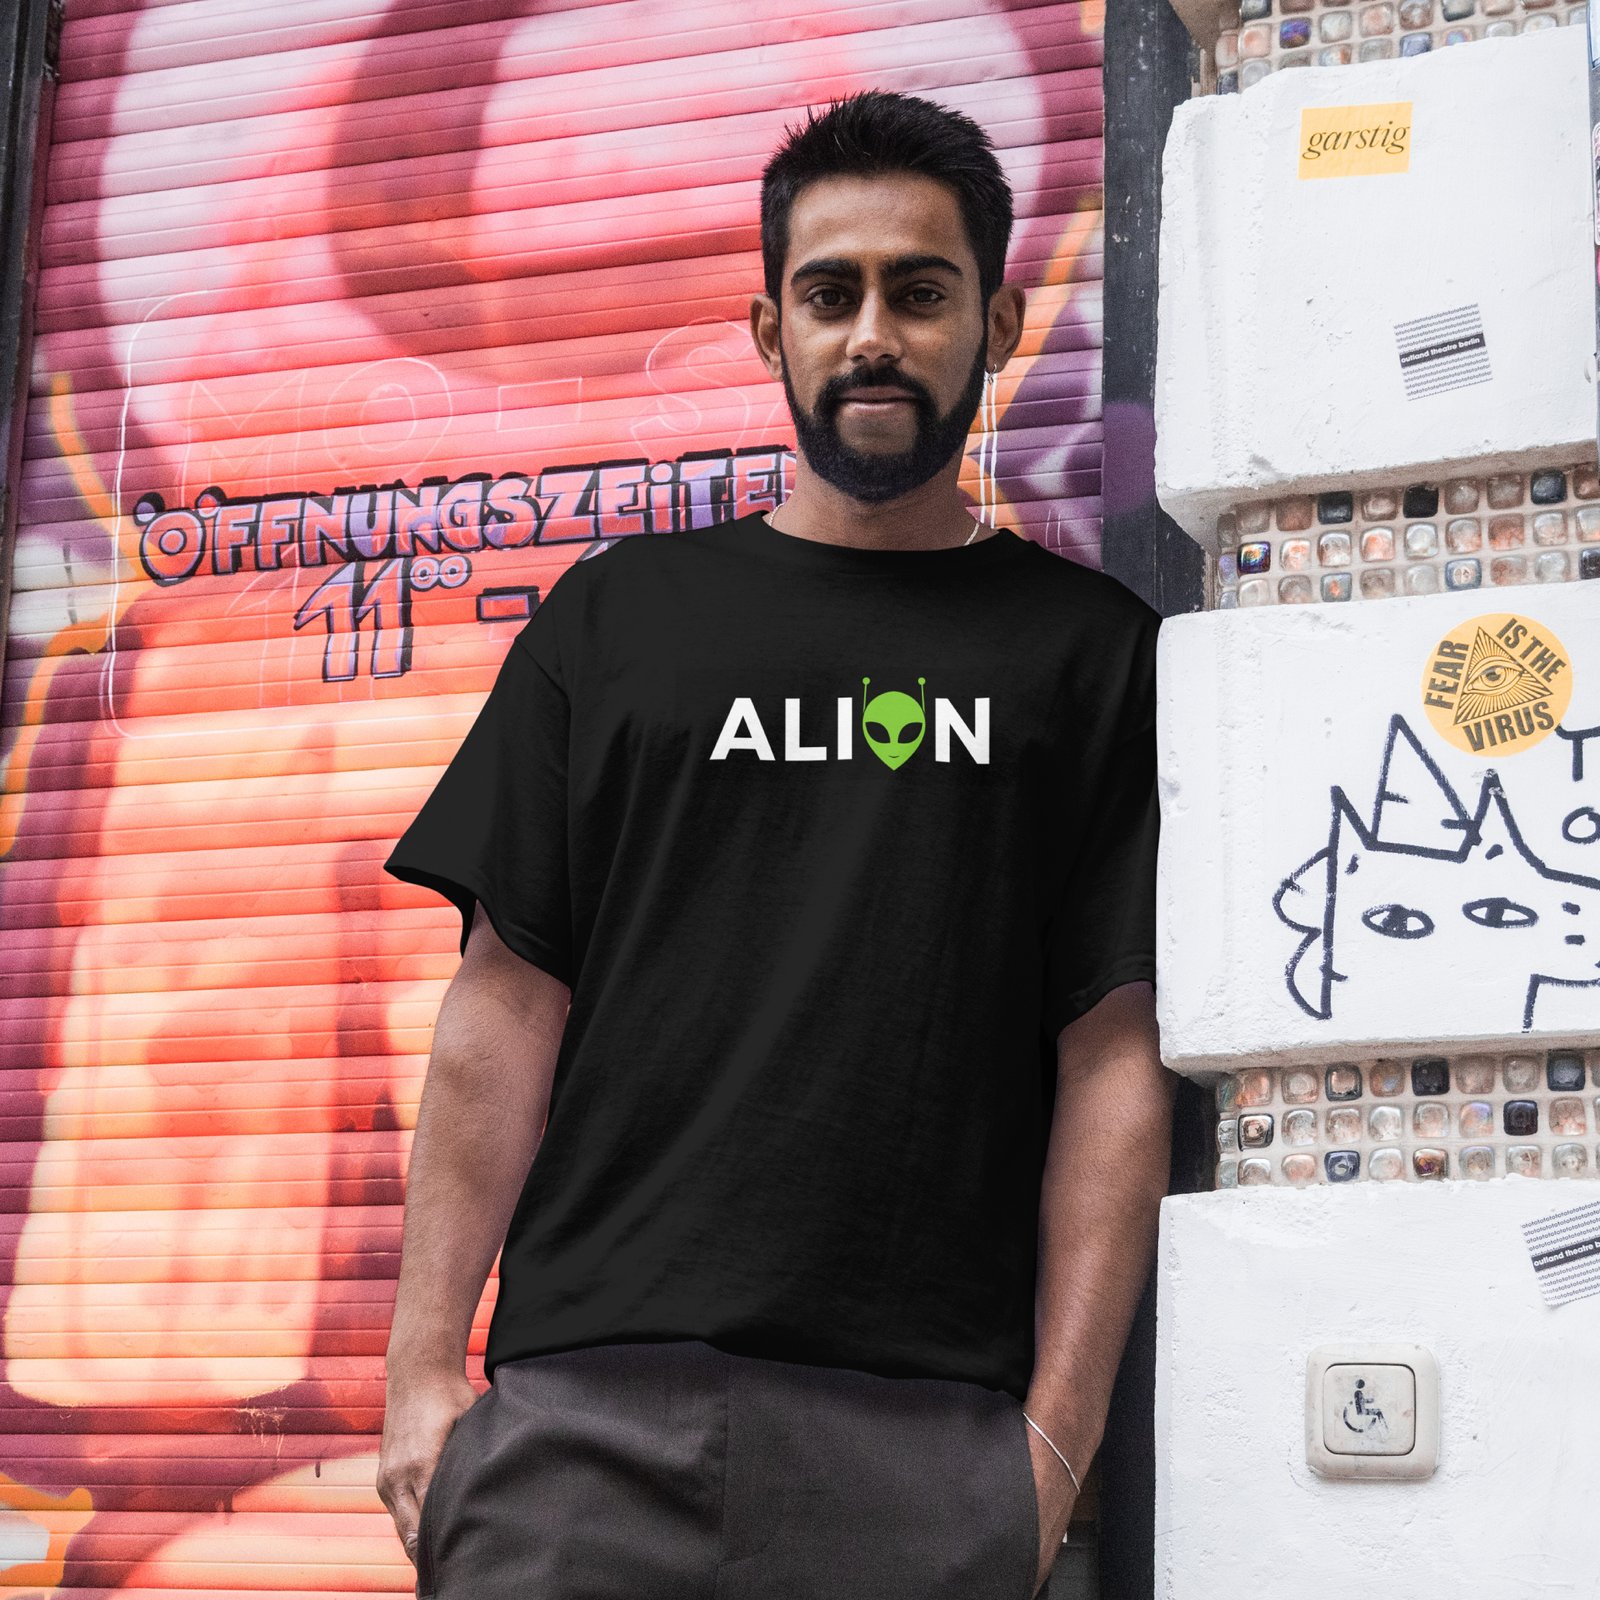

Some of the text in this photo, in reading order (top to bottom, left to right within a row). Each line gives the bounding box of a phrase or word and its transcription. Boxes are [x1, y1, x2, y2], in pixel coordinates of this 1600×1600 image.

[1302, 120, 1411, 160] garstig
[1430, 343, 1458, 356] theatre
[1458, 337, 1480, 348] berlin
[1424, 617, 1566, 752] FEAR IS THE VIRUS
[1534, 1252, 1564, 1267] outland
[1565, 1243, 1594, 1258] theatre
